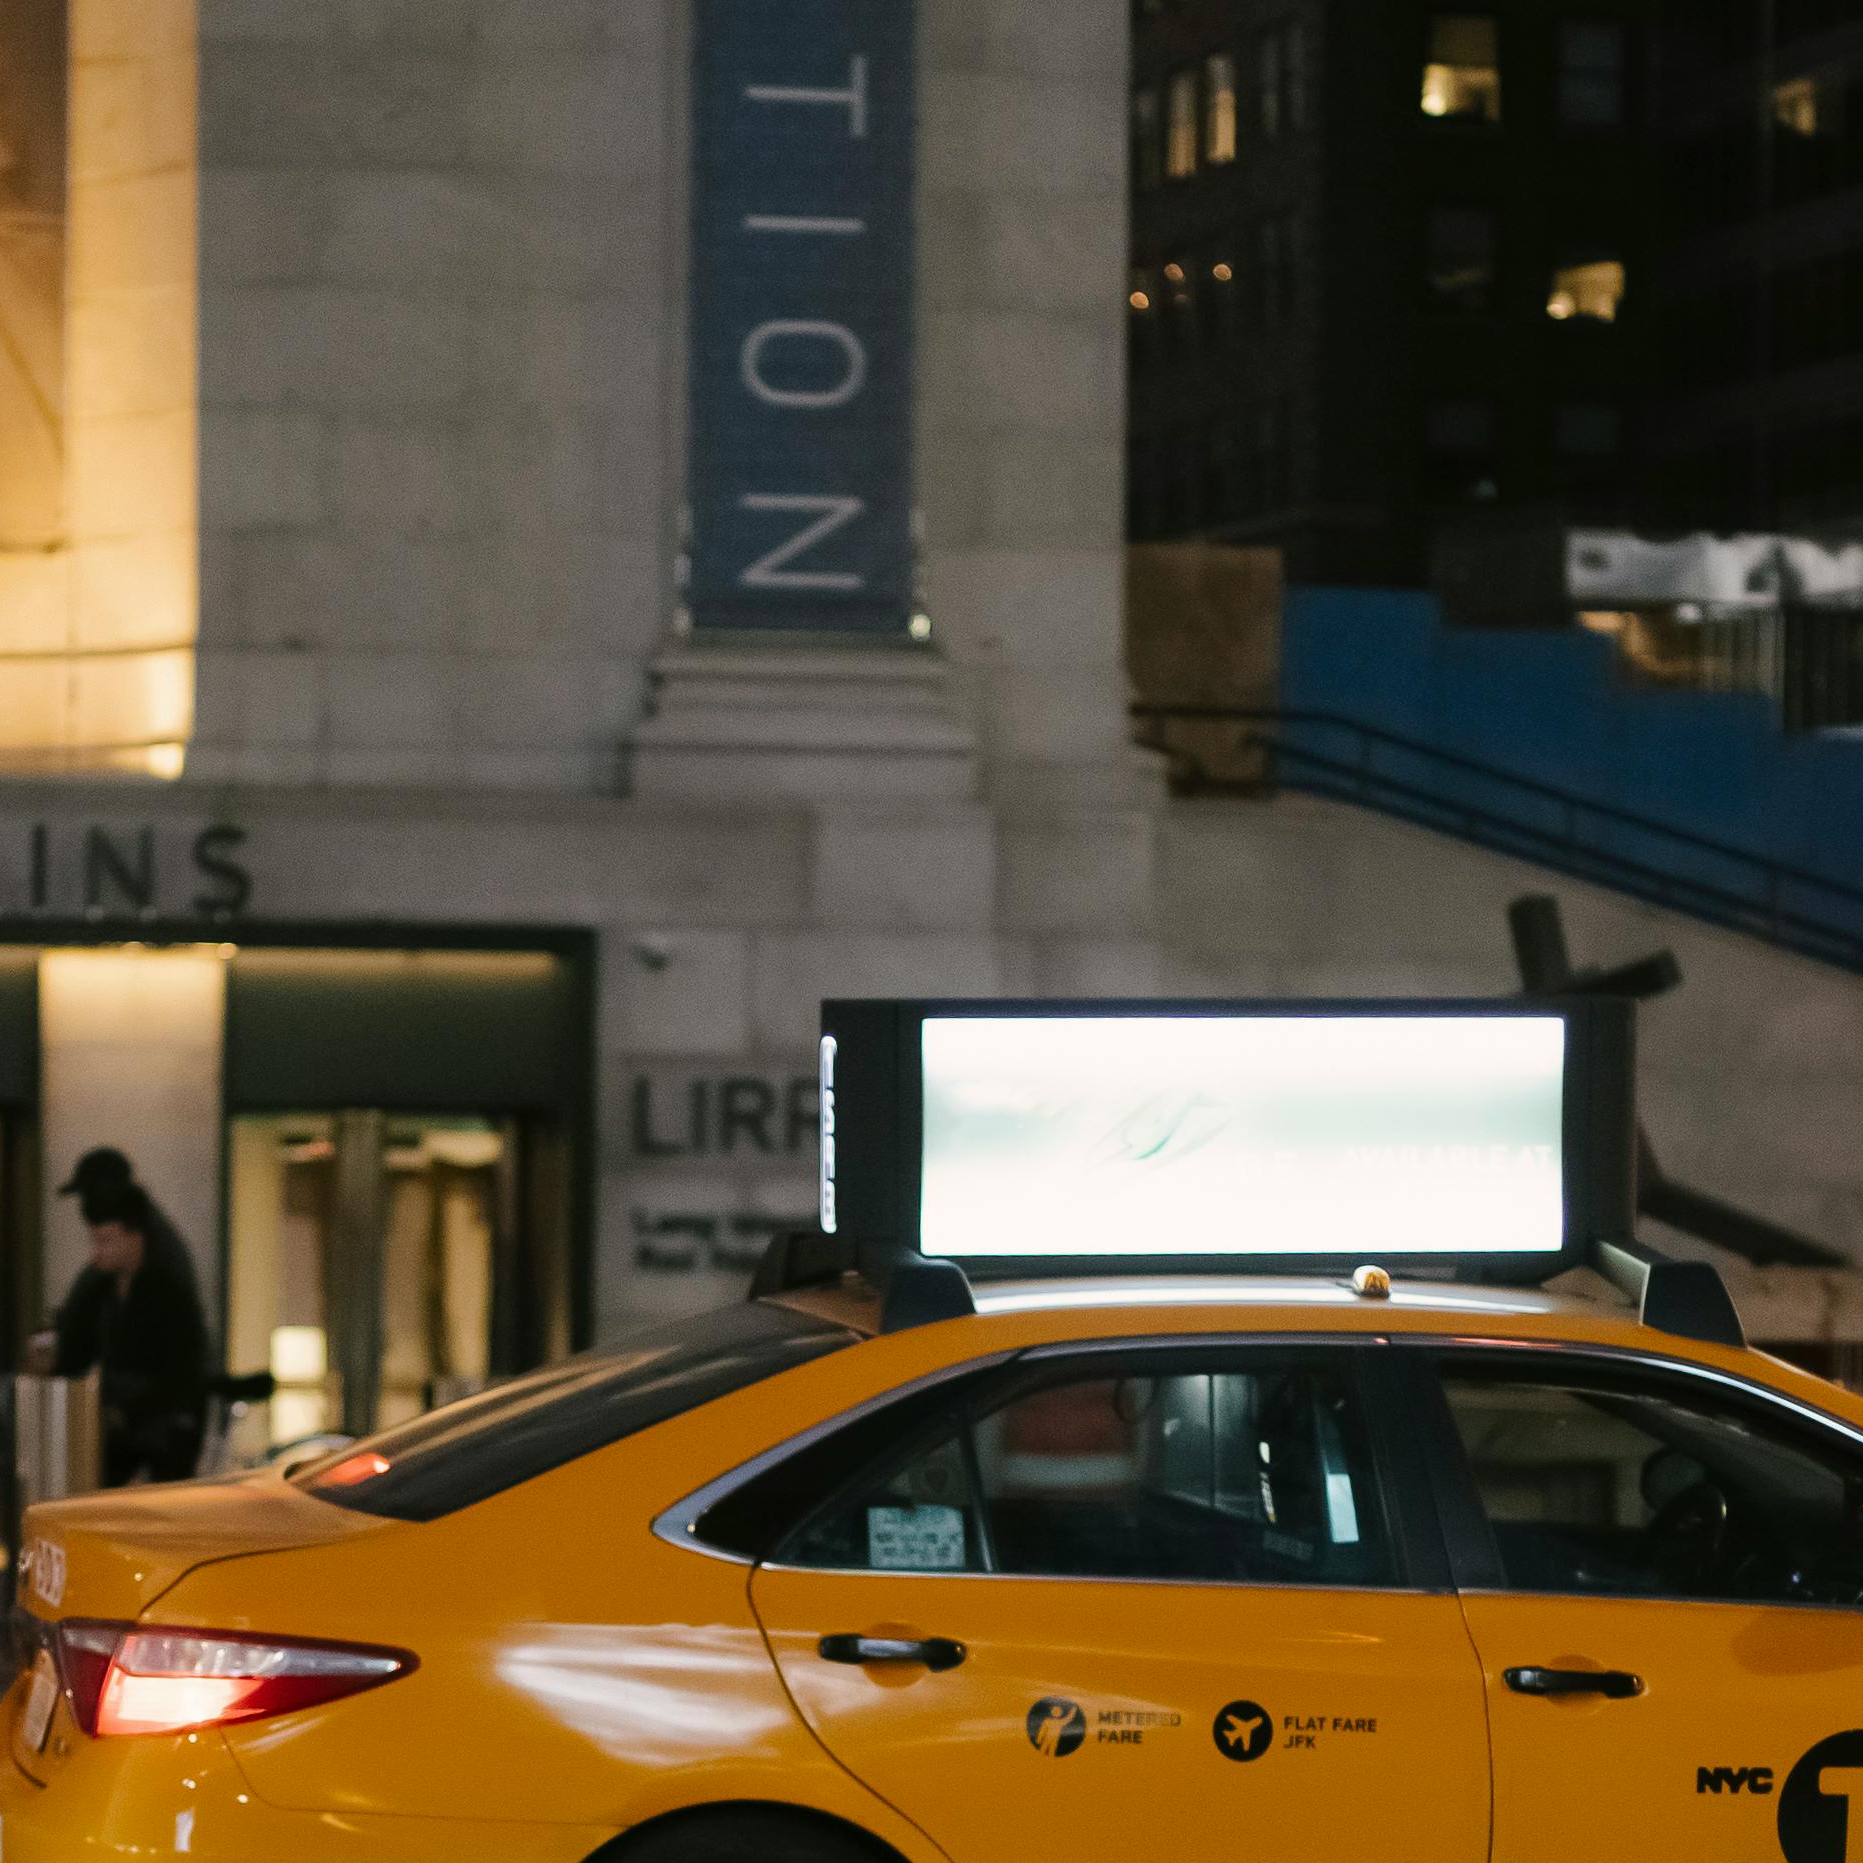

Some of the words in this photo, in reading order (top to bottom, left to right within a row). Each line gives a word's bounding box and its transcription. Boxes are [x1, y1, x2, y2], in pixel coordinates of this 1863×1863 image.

[740, 53, 868, 591] TION
[1283, 1716, 1329, 1733] FLAT
[1332, 1716, 1379, 1734] FARE
[1097, 1729, 1144, 1745] FARE
[1283, 1734, 1318, 1751] JFK
[1695, 1766, 1773, 1794] NYC
